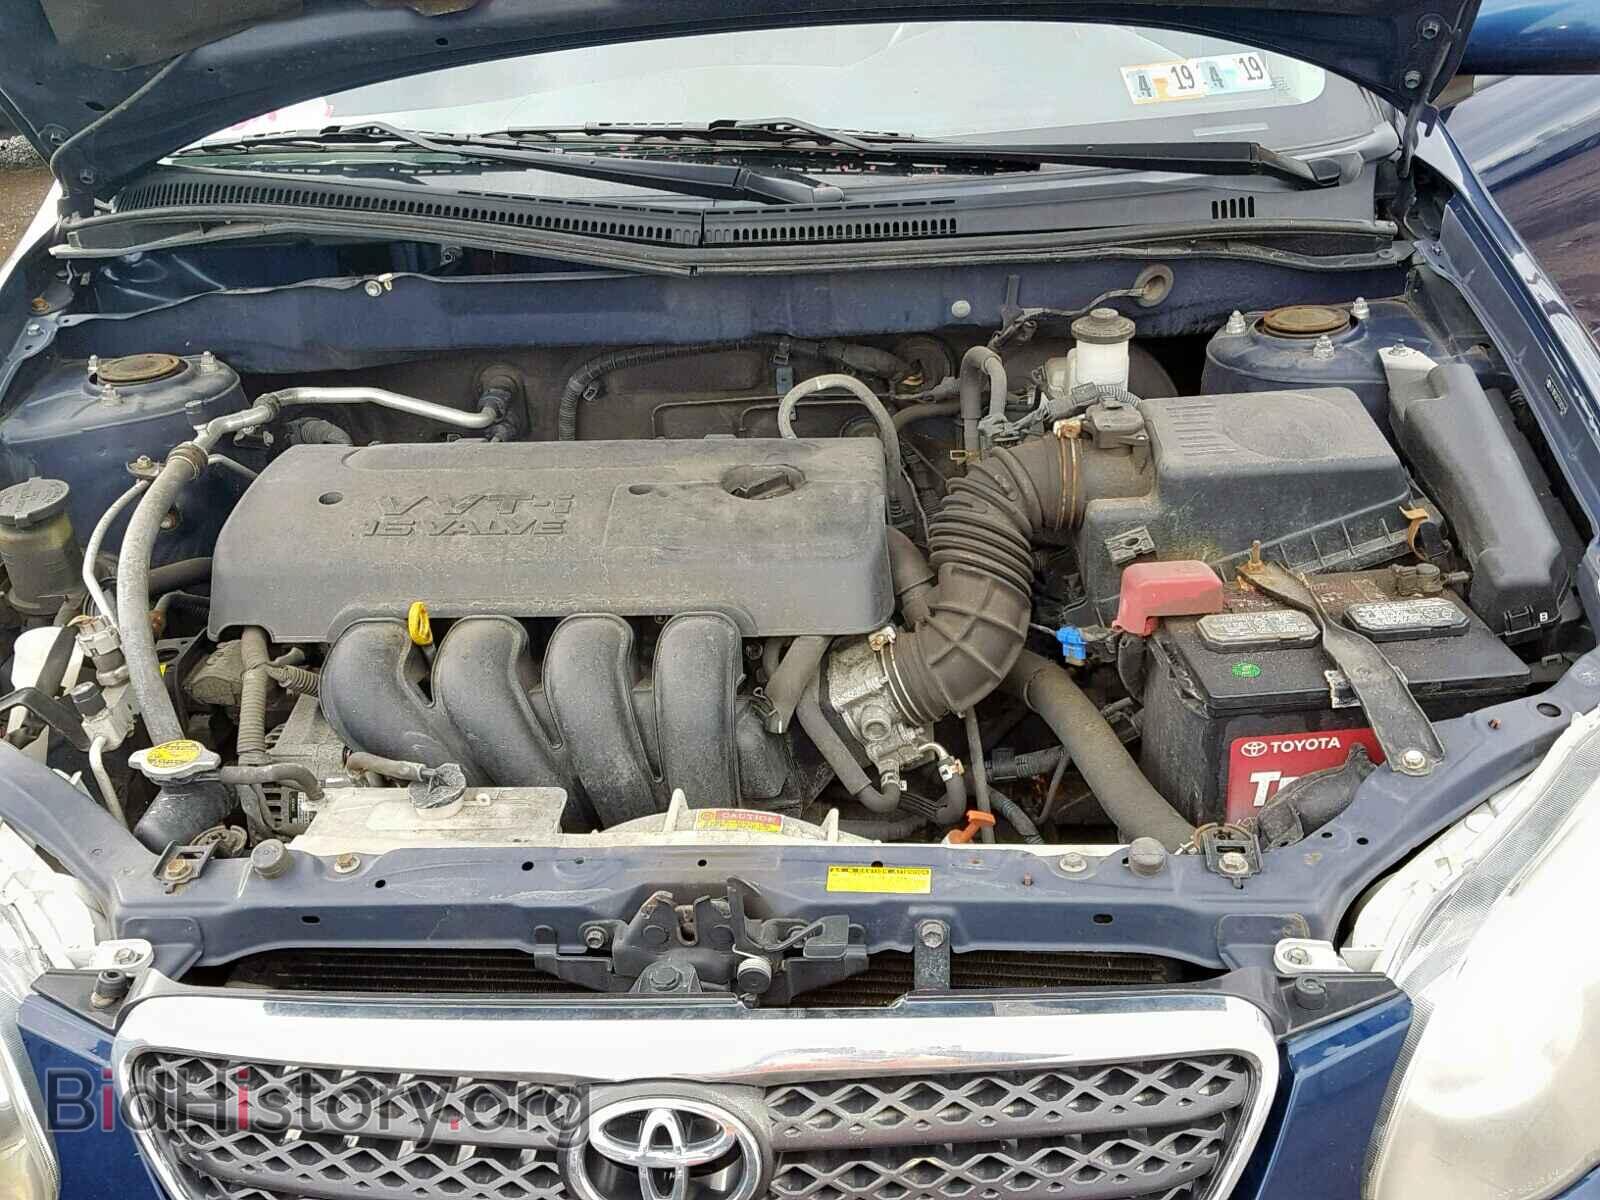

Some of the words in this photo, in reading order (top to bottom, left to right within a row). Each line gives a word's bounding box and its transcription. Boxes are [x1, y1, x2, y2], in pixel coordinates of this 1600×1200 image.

[1137, 75, 1152, 97] 4
[1171, 65, 1195, 90] 19
[1208, 66, 1224, 89] 4
[1238, 56, 1264, 81] 19
[429, 519, 566, 537] VALVE
[1270, 737, 1341, 754] TOYOTA
[721, 812, 775, 822] CAUTION
